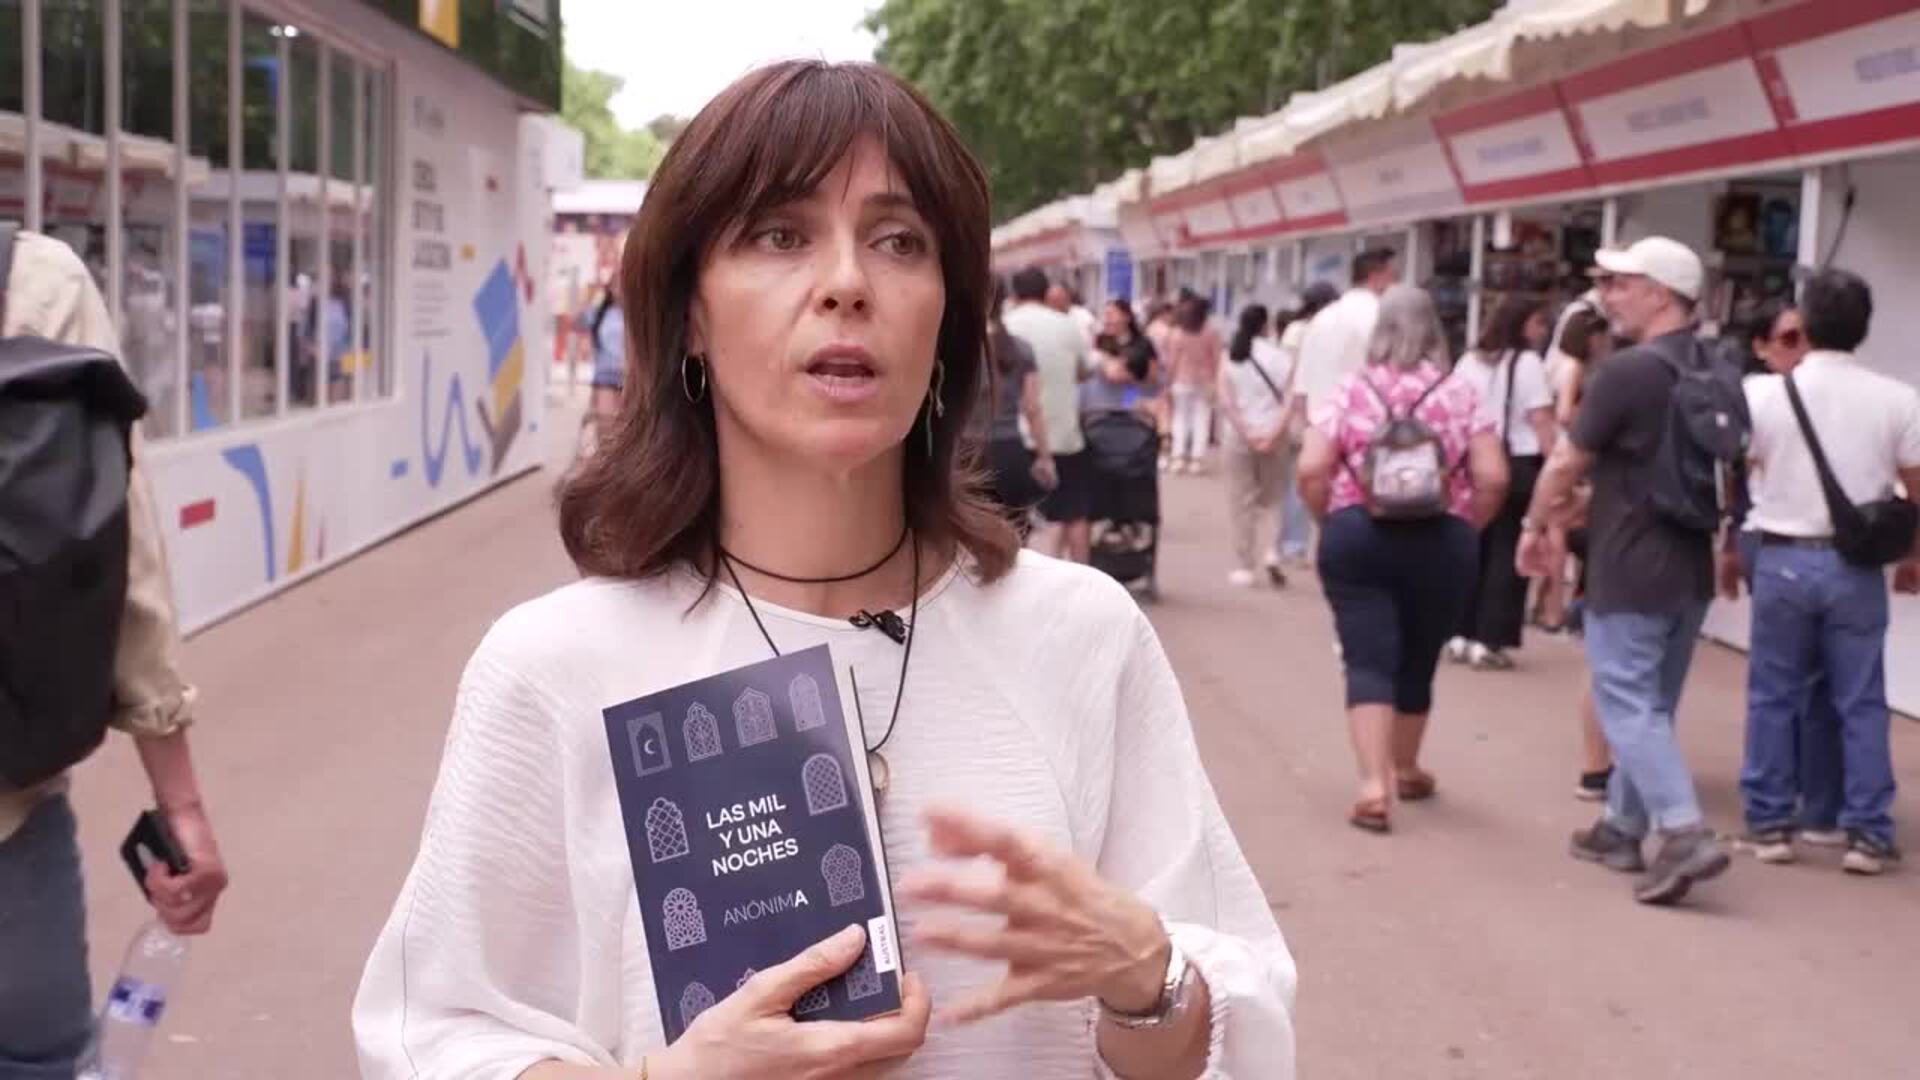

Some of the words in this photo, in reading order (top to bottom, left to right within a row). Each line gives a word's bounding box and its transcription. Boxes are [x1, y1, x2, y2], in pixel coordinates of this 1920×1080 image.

[705, 803, 746, 829] LAS
[748, 793, 786, 818] MIL
[718, 829, 733, 849] Y
[736, 818, 782, 844] UNA
[711, 838, 799, 877] NOCHES
